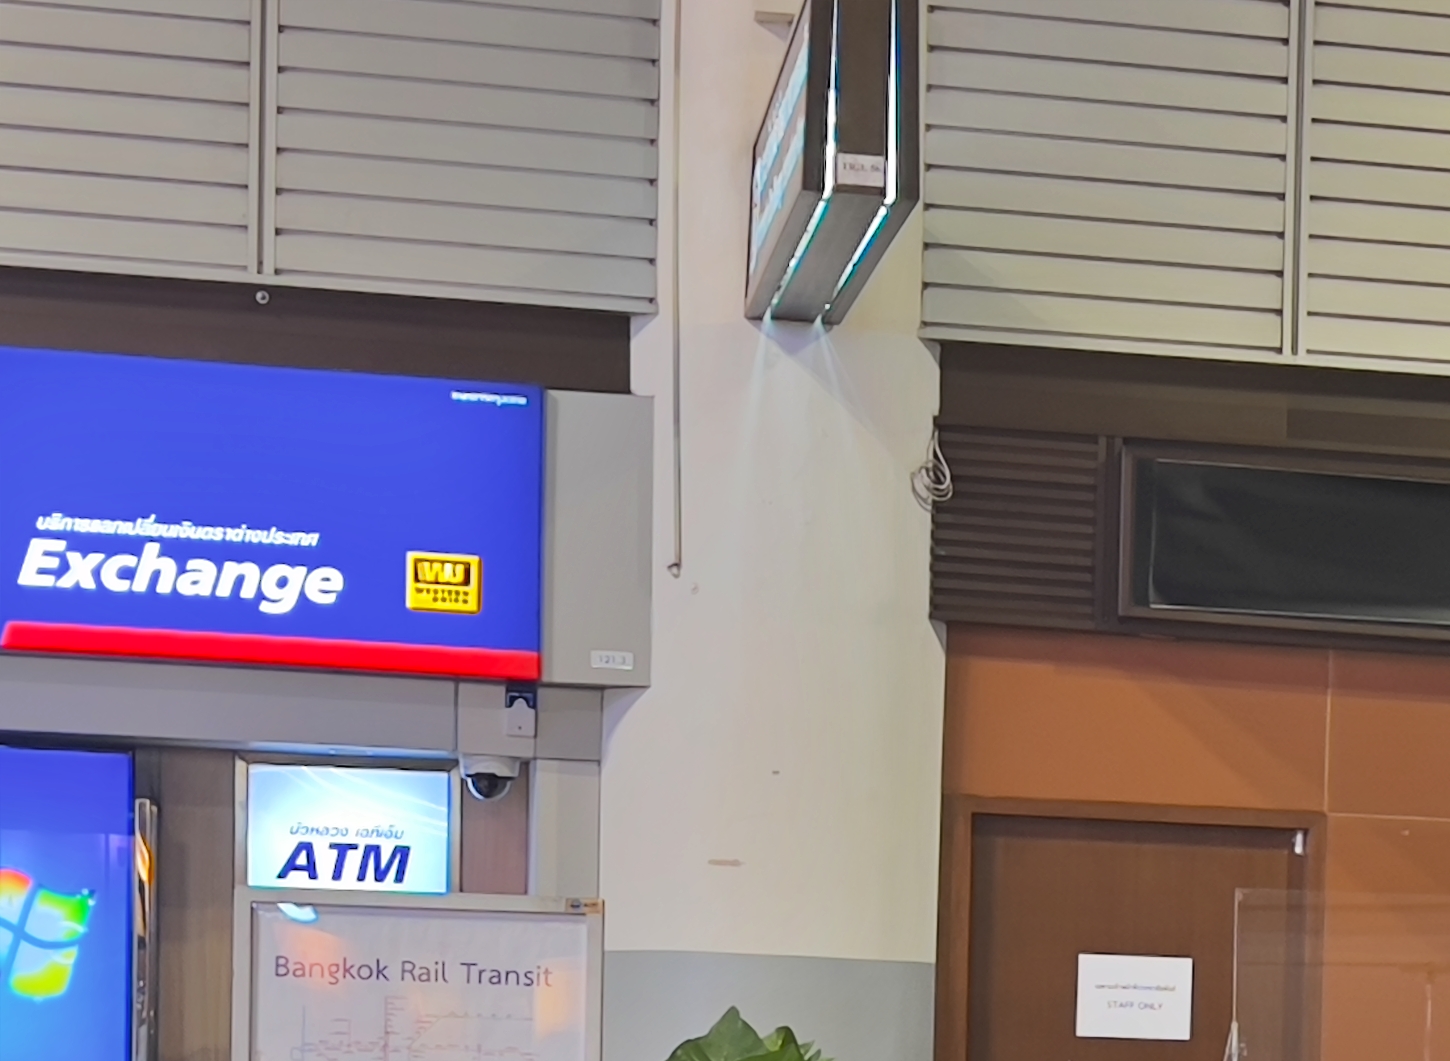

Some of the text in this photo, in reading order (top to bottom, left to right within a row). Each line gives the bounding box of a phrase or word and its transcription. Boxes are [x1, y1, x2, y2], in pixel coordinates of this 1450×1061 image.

[17, 537, 344, 615] Exchange
[275, 841, 412, 884] ATM
[275, 955, 554, 988] Bangkok Rail Transit
